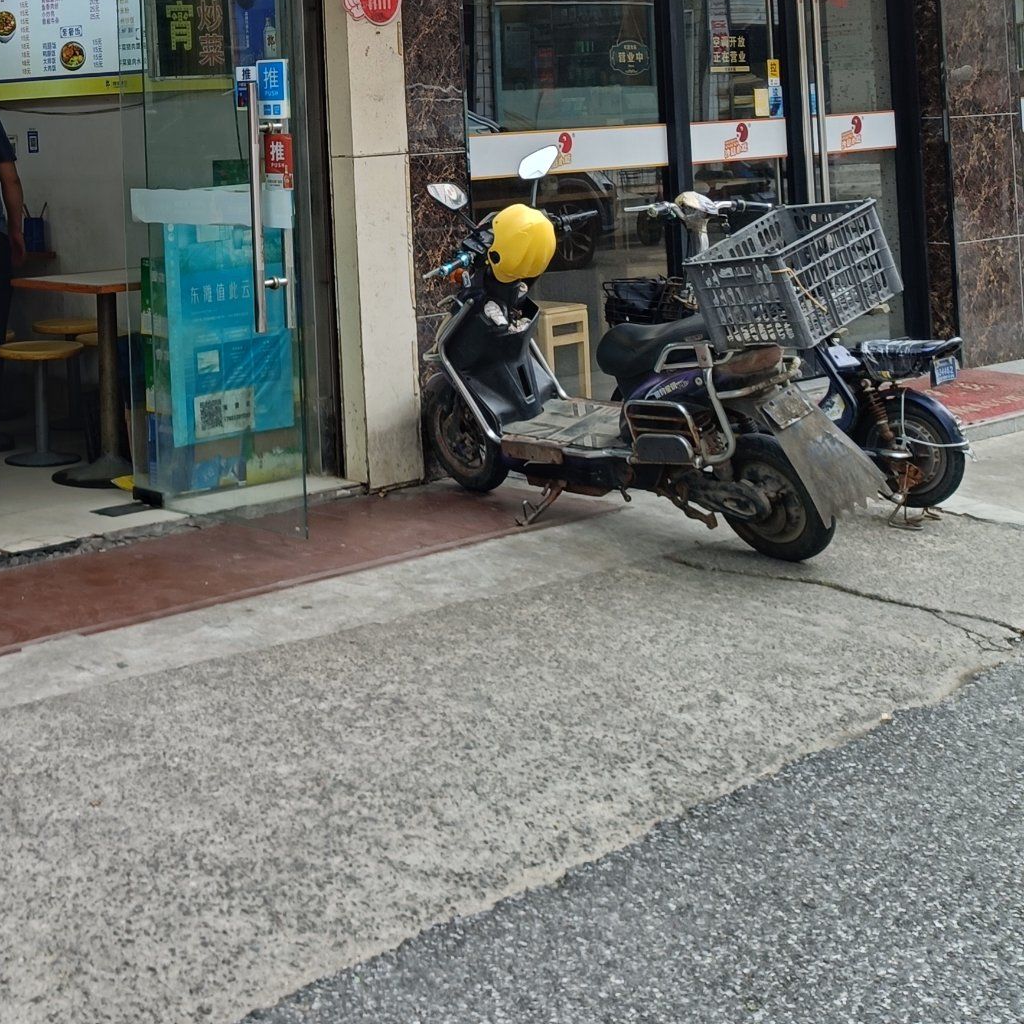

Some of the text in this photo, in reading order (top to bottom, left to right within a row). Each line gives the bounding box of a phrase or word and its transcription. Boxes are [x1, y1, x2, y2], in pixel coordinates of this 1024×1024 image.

[618, 51, 644, 63] 营业中
[713, 50, 746, 63] 正在营业
[241, 68, 251, 81] 推
[263, 66, 280, 90] 推
[269, 140, 285, 162] 推
